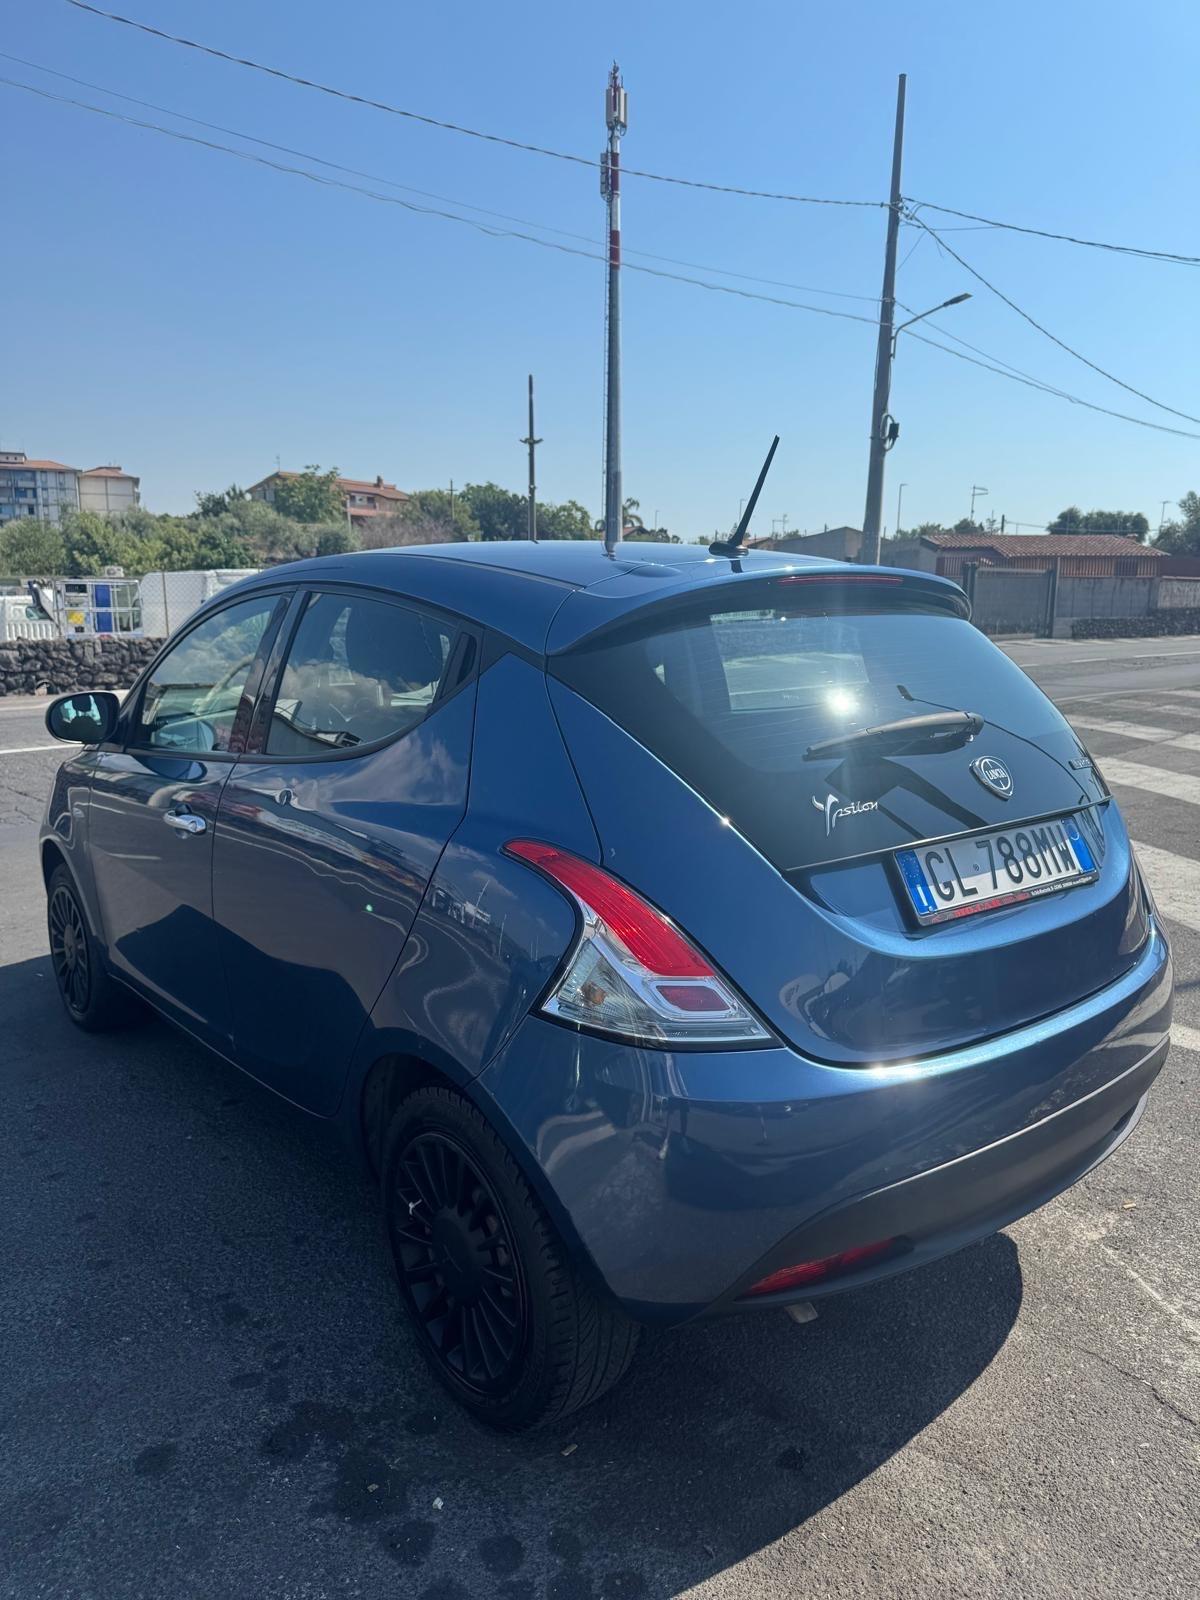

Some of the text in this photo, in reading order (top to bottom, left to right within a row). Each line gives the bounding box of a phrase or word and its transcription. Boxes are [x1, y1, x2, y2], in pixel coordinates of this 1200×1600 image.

[985, 768, 1007, 780] LANCIA
[811, 793, 878, 837] Ypsilon
[925, 824, 1076, 902] GL 788MW
